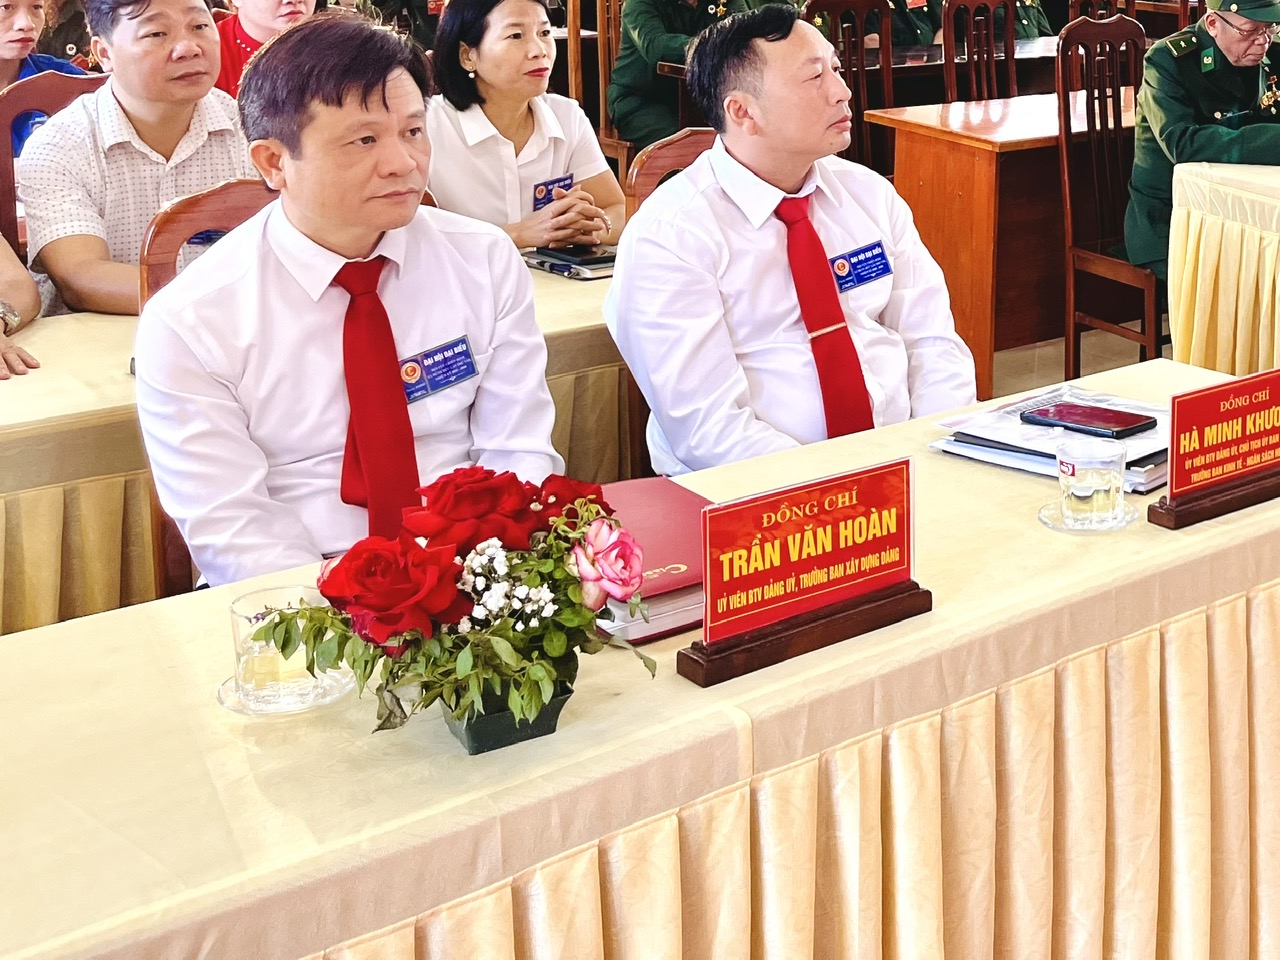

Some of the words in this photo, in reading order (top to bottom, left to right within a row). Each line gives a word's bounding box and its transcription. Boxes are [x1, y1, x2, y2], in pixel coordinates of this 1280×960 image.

[1220, 394, 1250, 412] ĐỒNG
[1252, 386, 1270, 403] CHÍ
[1180, 426, 1200, 454] HÀ
[1204, 417, 1242, 447] MINH
[762, 501, 818, 528] ĐỒNG
[823, 486, 858, 512] CHÍ
[720, 534, 781, 581] TRẦN
[788, 524, 832, 563] VĂN
[839, 507, 897, 548] HOÀN
[729, 590, 747, 610] VIÊN
[748, 588, 762, 605] BTV
[764, 578, 785, 600] ĐẢNG
[829, 565, 844, 580] BAN
[846, 556, 859, 576] XÂY
[860, 552, 880, 573] DỰNG
[881, 546, 900, 566] ĐẢNG
